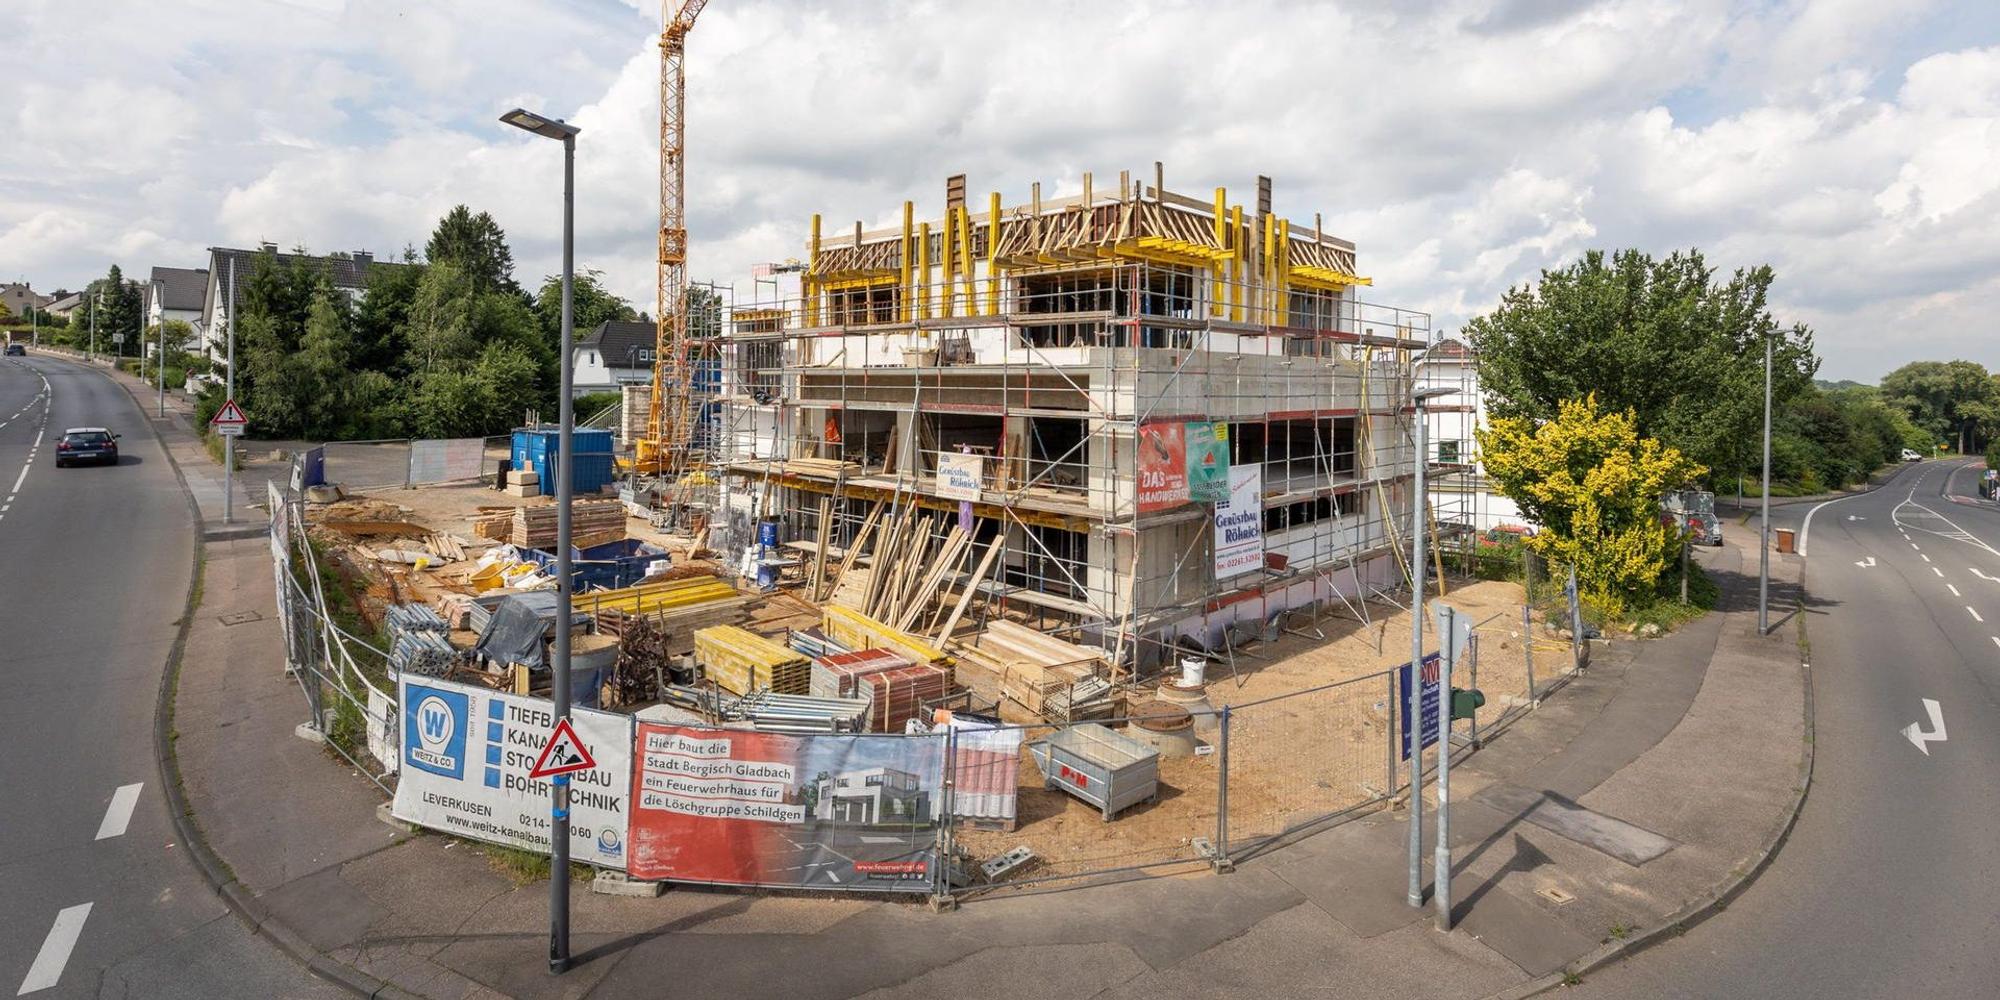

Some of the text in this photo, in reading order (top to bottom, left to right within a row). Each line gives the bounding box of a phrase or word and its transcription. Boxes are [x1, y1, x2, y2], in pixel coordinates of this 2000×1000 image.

[1142, 471, 1165, 488] DAS
[425, 709, 445, 737] W
[649, 736, 727, 754] Hier baut die
[647, 756, 791, 779] Stadt Bergisch Gladbach
[505, 773, 620, 813] BOHRCHNIK
[645, 777, 780, 798] ein Feuerwehrhaus für
[423, 791, 492, 817] LEVERKUSEN
[644, 794, 801, 822] die Löschgruppe Schildgen
